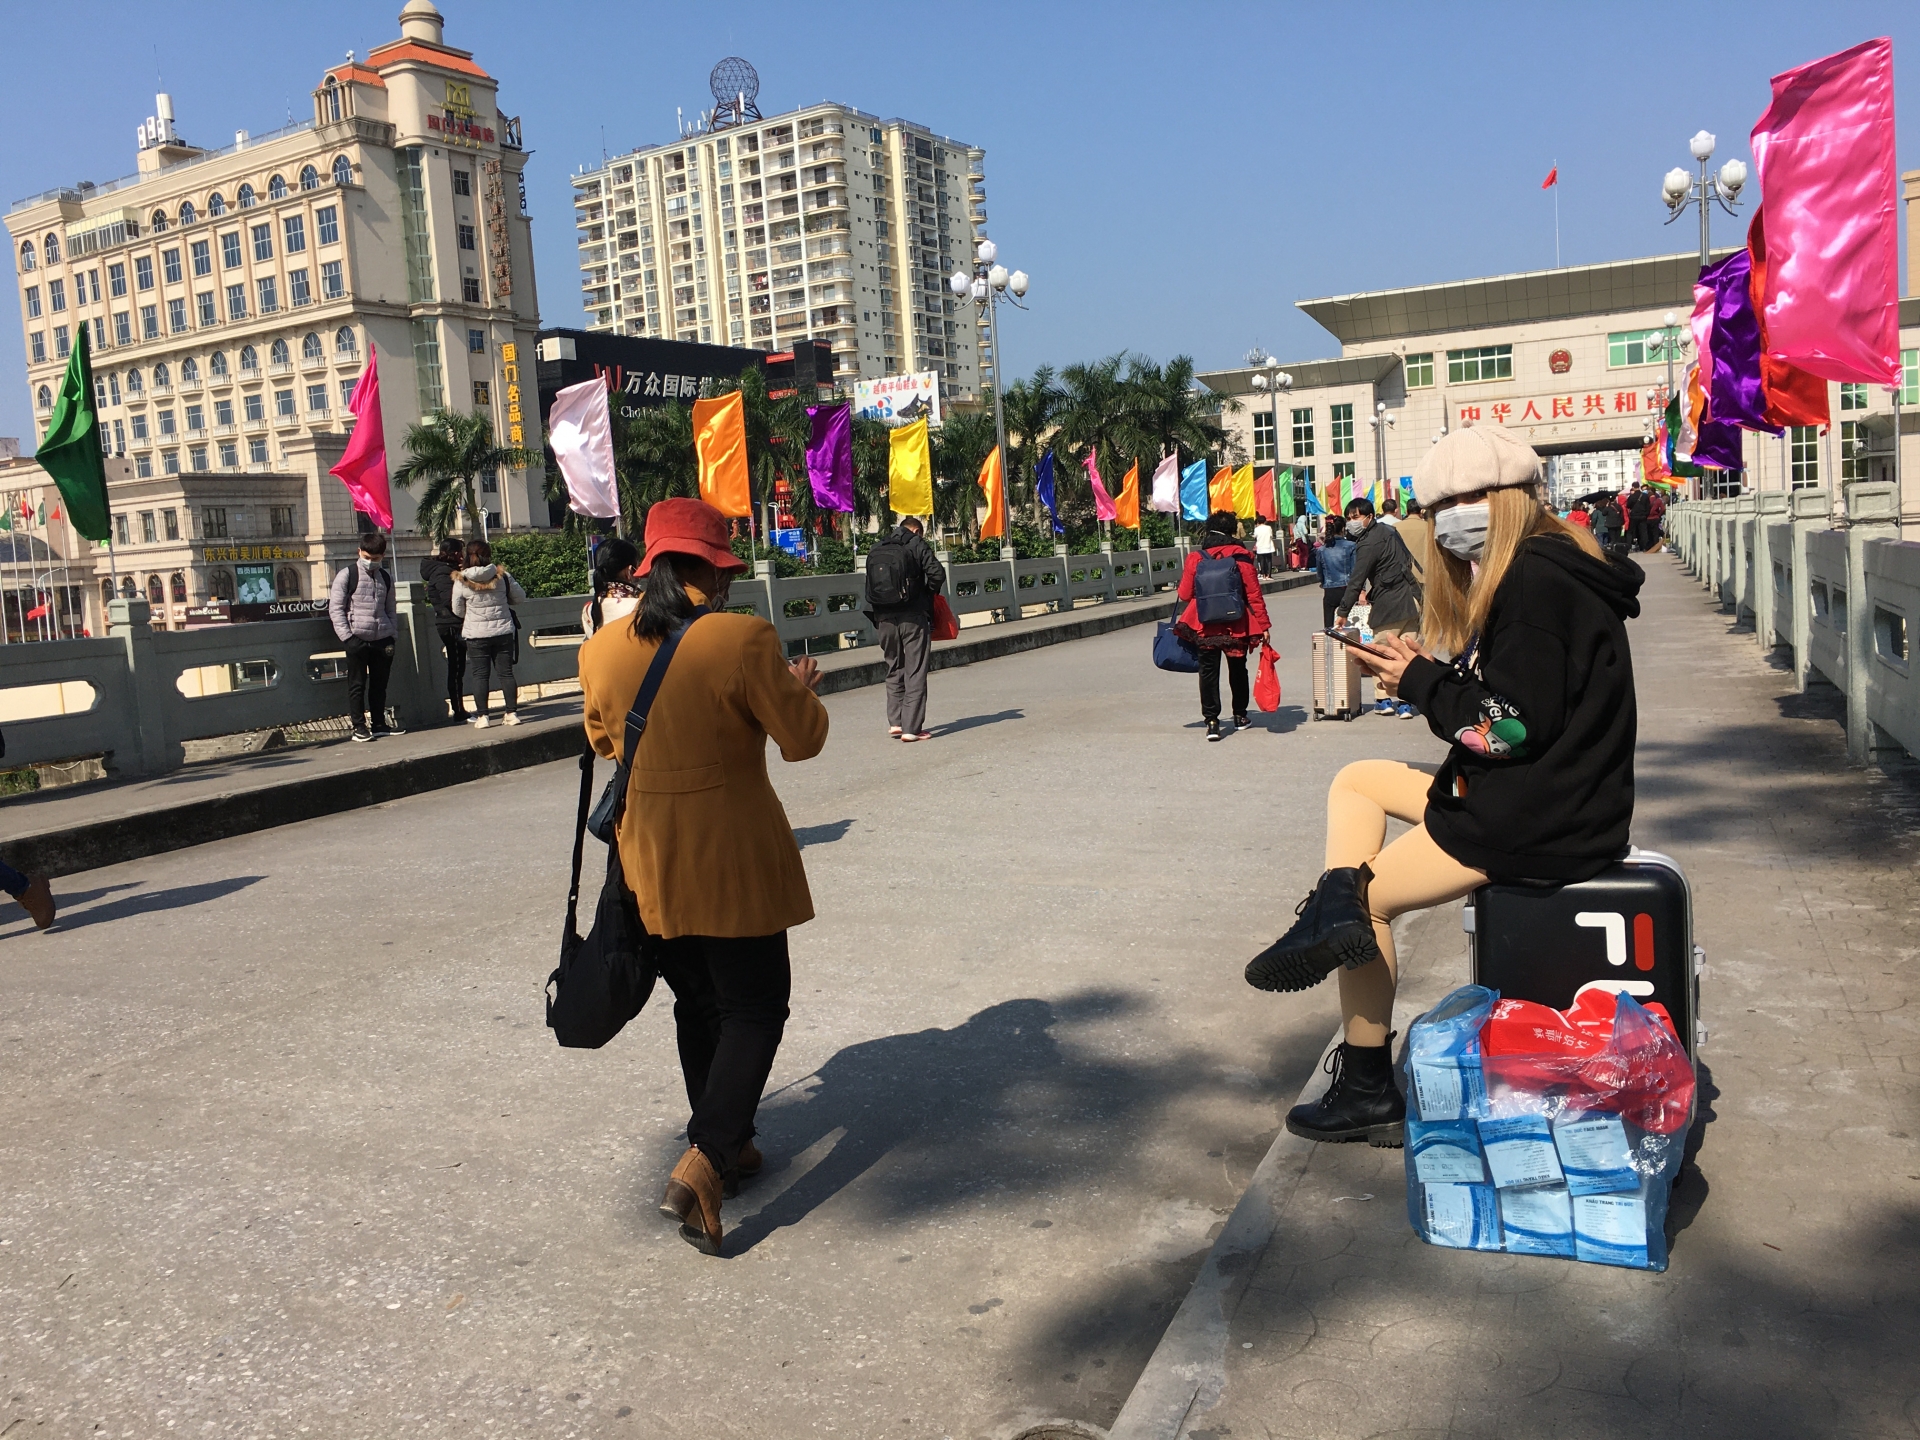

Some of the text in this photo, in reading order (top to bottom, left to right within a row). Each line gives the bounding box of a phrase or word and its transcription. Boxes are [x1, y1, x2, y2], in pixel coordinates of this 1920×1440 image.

[1460, 386, 1670, 424] 中华人民共和国
[205, 546, 282, 561] 东兴市吴川商会
